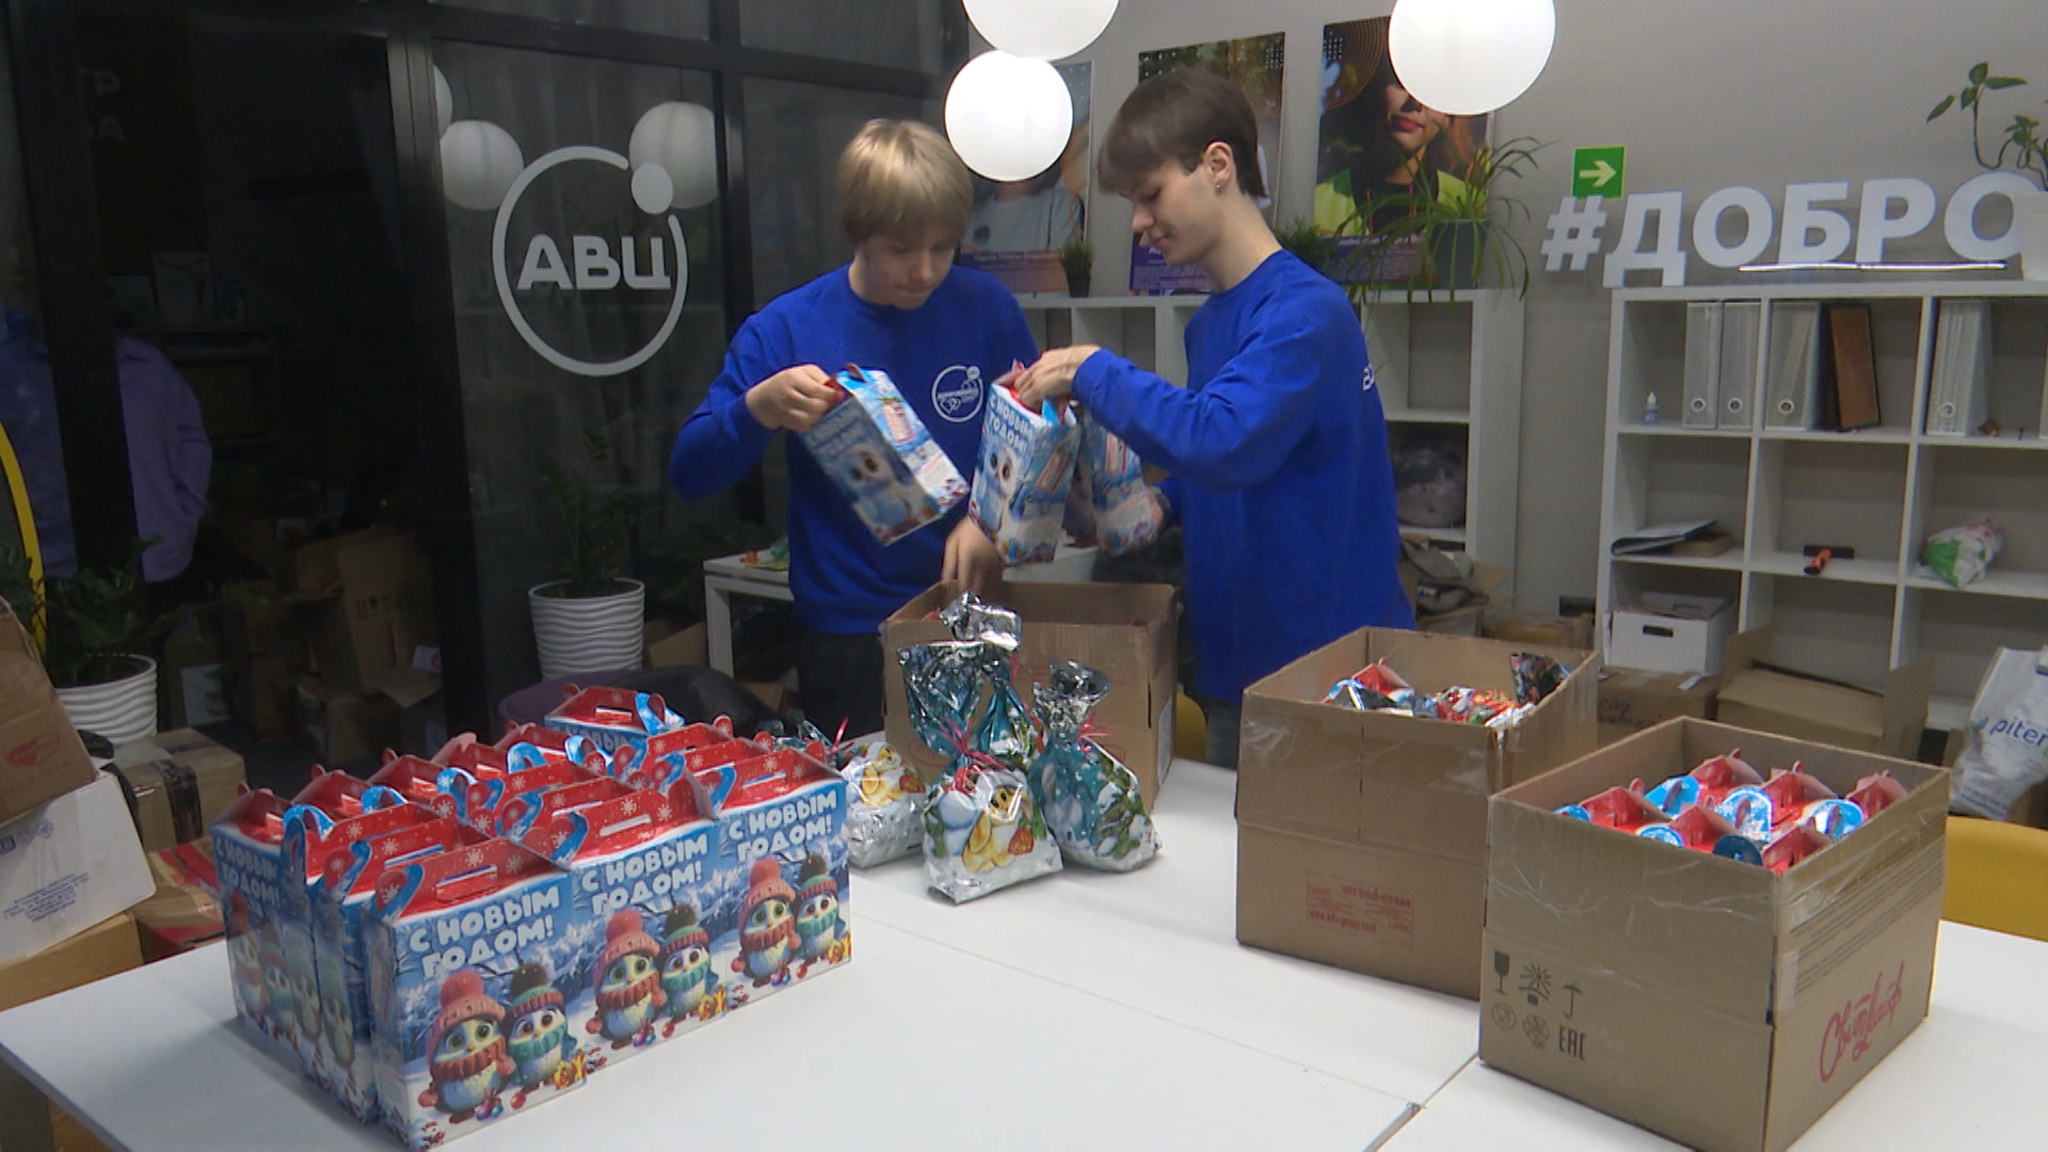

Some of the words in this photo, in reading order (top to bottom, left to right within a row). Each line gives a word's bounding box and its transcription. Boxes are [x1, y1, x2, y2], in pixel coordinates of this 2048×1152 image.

[516, 233, 672, 290] АВЦ
[729, 821, 744, 840] С
[748, 790, 837, 835] НОВЫМ
[737, 814, 832, 862] ГОДОМ!
[222, 861, 281, 909] ГОДОМ!
[225, 840, 278, 881] НОВЫМ
[581, 869, 600, 892] С
[605, 833, 708, 886] НОВЫМ
[591, 860, 702, 916] ГОДОМ!
[409, 928, 431, 952] С
[436, 886, 560, 946] НОВЫМ
[421, 914, 554, 979] ГОДОМ!
